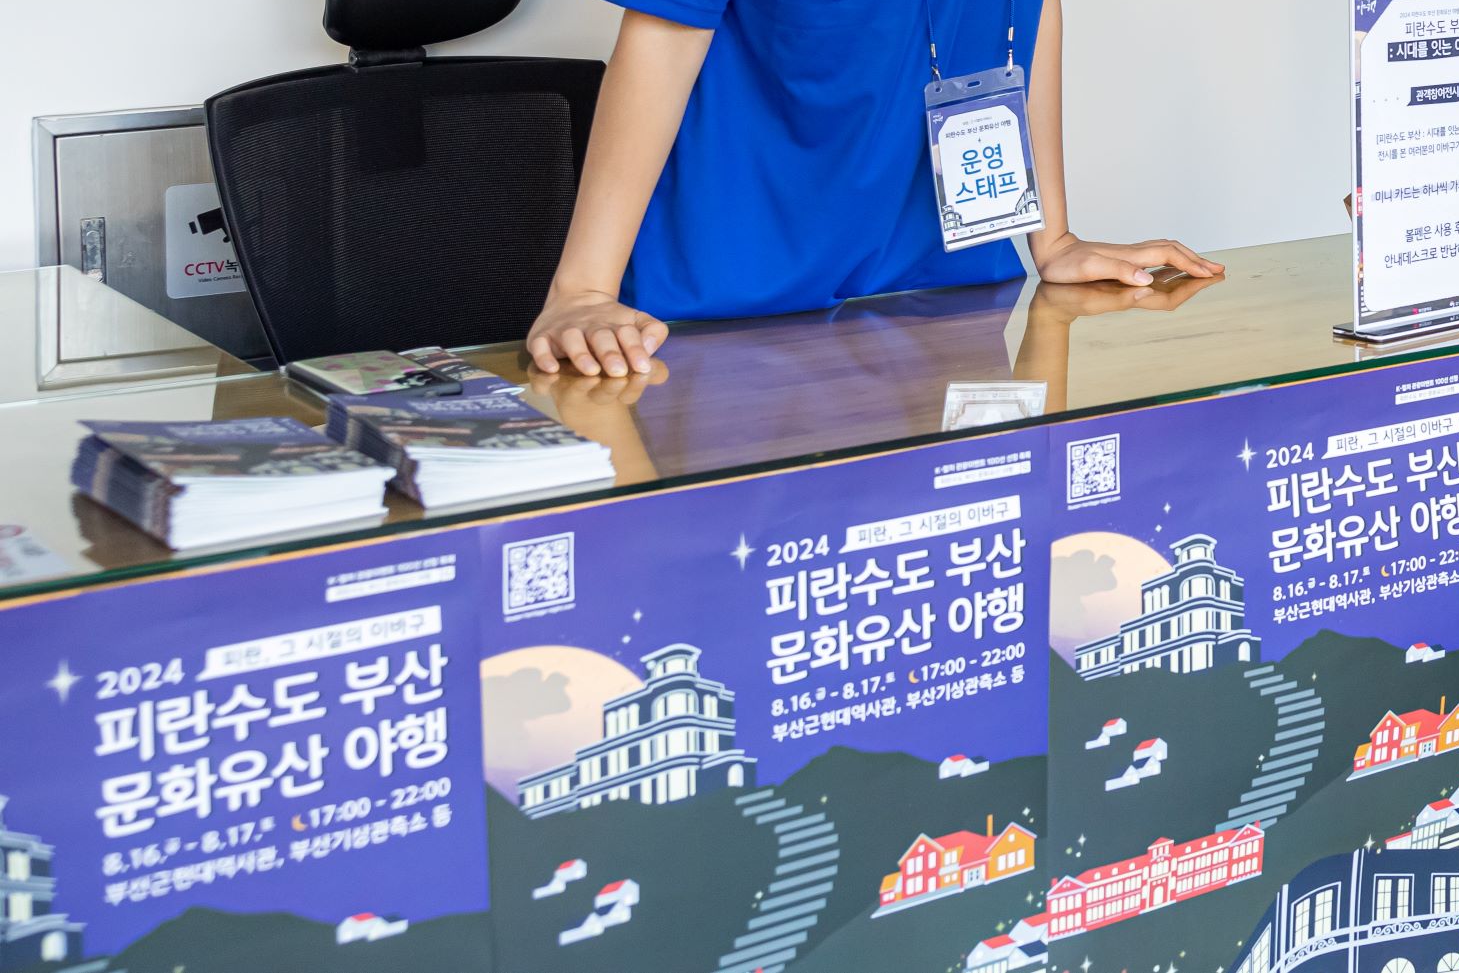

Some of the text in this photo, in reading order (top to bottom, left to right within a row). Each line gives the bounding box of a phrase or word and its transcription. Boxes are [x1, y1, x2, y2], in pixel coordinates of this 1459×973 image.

[1396, 41, 1428, 60] 시대를
[1432, 39, 1452, 55] 잇는
[1405, 20, 1446, 38] 피란수도
[1416, 86, 1459, 102] 관객참여전시
[1378, 148, 1398, 161] 전시를
[1409, 144, 1434, 156] 여러분의
[1408, 129, 1420, 140] 부산
[1427, 126, 1446, 137] 시대를
[1448, 125, 1459, 136] 잇는
[961, 143, 1004, 175] 운영
[956, 172, 1020, 204] 스태프
[1376, 190, 1392, 203] 미니
[1394, 186, 1420, 200] 카드는
[1422, 181, 1448, 196] 하나씩
[1406, 226, 1432, 242] 볼펜은
[1434, 223, 1452, 238] 사용
[1384, 248, 1438, 268] 안내데스크로
[1265, 414, 1454, 469] 2024 피란, 그 시절의 이바구
[1266, 457, 1398, 518] 피란수도
[766, 500, 1010, 567] 2024 피란, 그 시절의 이바구
[1268, 504, 1401, 575] 문화유산
[765, 528, 1026, 621] 피란수도 부산
[1390, 554, 1426, 576] 17:00
[1273, 588, 1376, 624] 부산근현대역사관,
[1379, 571, 1459, 601] 부산기상관측소
[766, 582, 1026, 684] 문화유산 야행
[96, 658, 185, 700] 2024
[920, 658, 966, 682] 17:00
[982, 642, 1026, 668] 22:00
[94, 644, 448, 762] 피란수도 부산
[772, 664, 1026, 744] 부산근현대역사관, 부산기상관측소 등
[95, 708, 448, 839] 문화유산 야행
[308, 798, 372, 828] 17:00
[390, 777, 452, 810] 22:00
